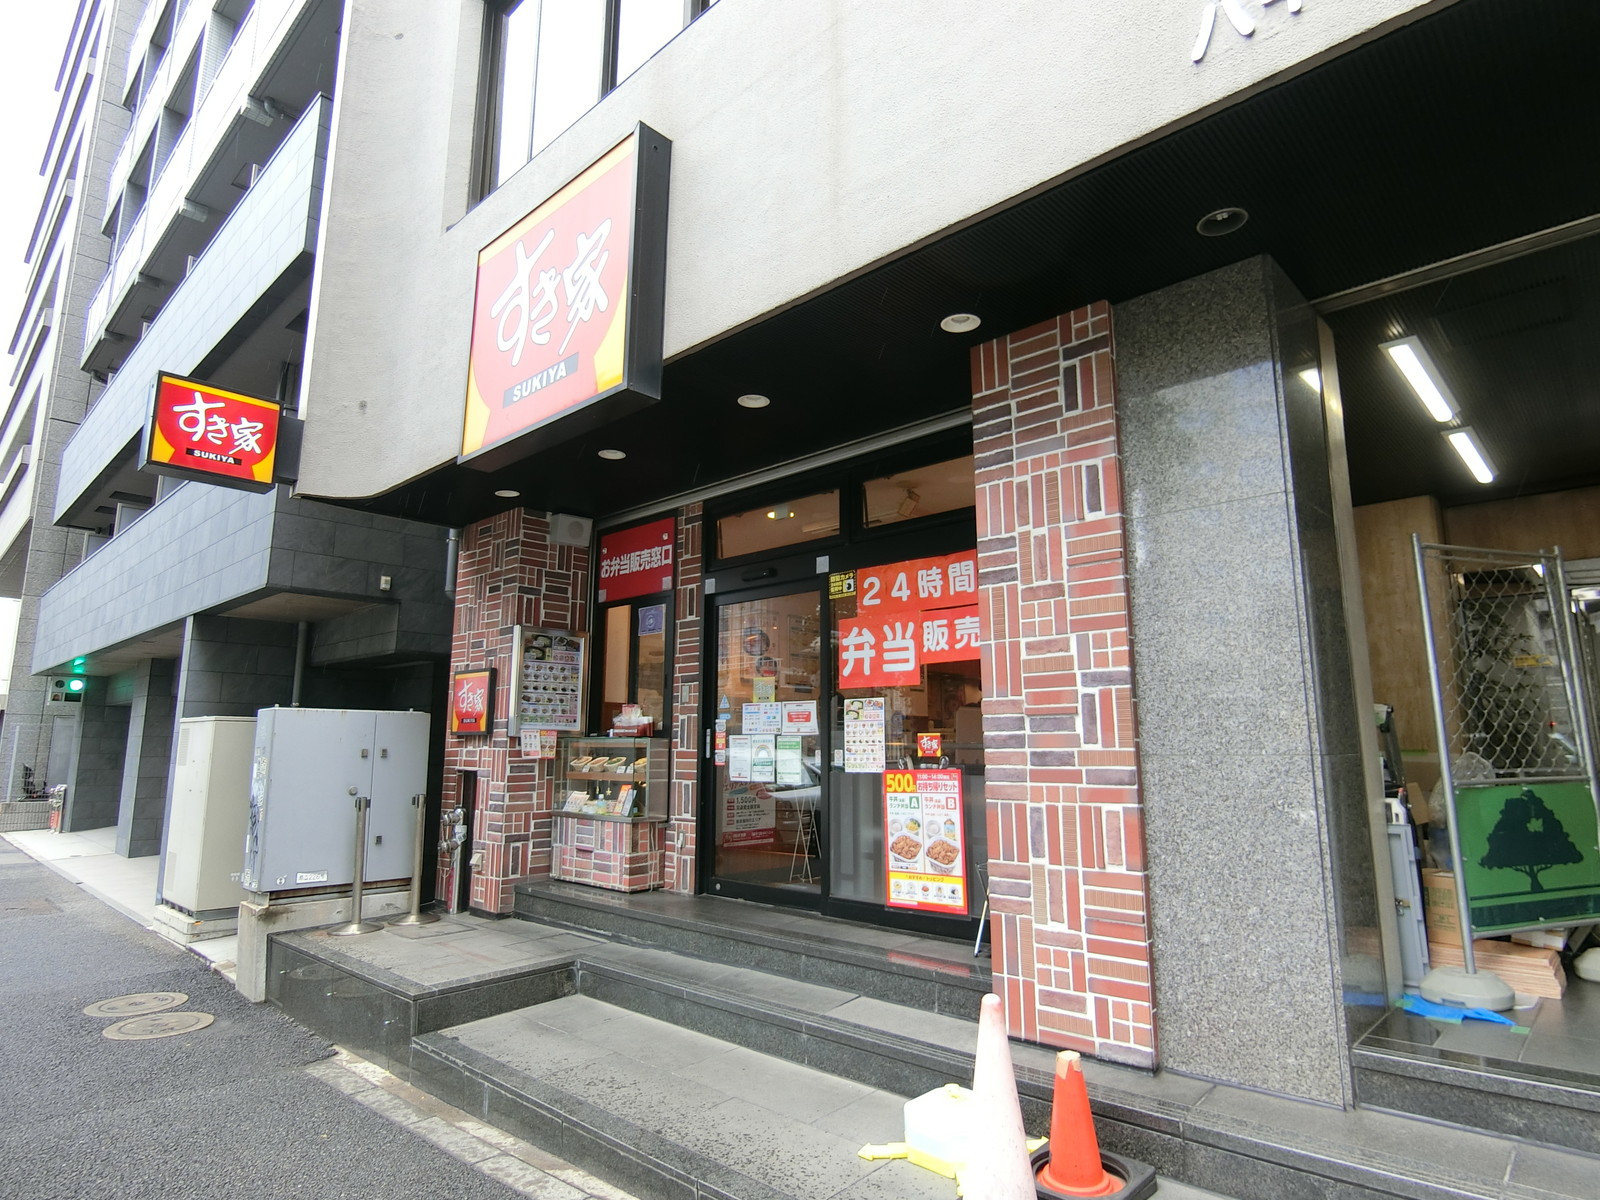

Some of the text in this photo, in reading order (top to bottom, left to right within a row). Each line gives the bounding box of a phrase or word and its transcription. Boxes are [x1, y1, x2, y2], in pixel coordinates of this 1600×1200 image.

[490, 217, 613, 367] すき家
[512, 361, 567, 402] SUKIYA
[172, 391, 264, 455] すき家
[193, 449, 235, 464] SUKIYA
[600, 544, 673, 578] お弁当販売窓口
[862, 560, 975, 606] 24時間
[457, 679, 485, 717] すき家
[910, 797, 918, 809] A
